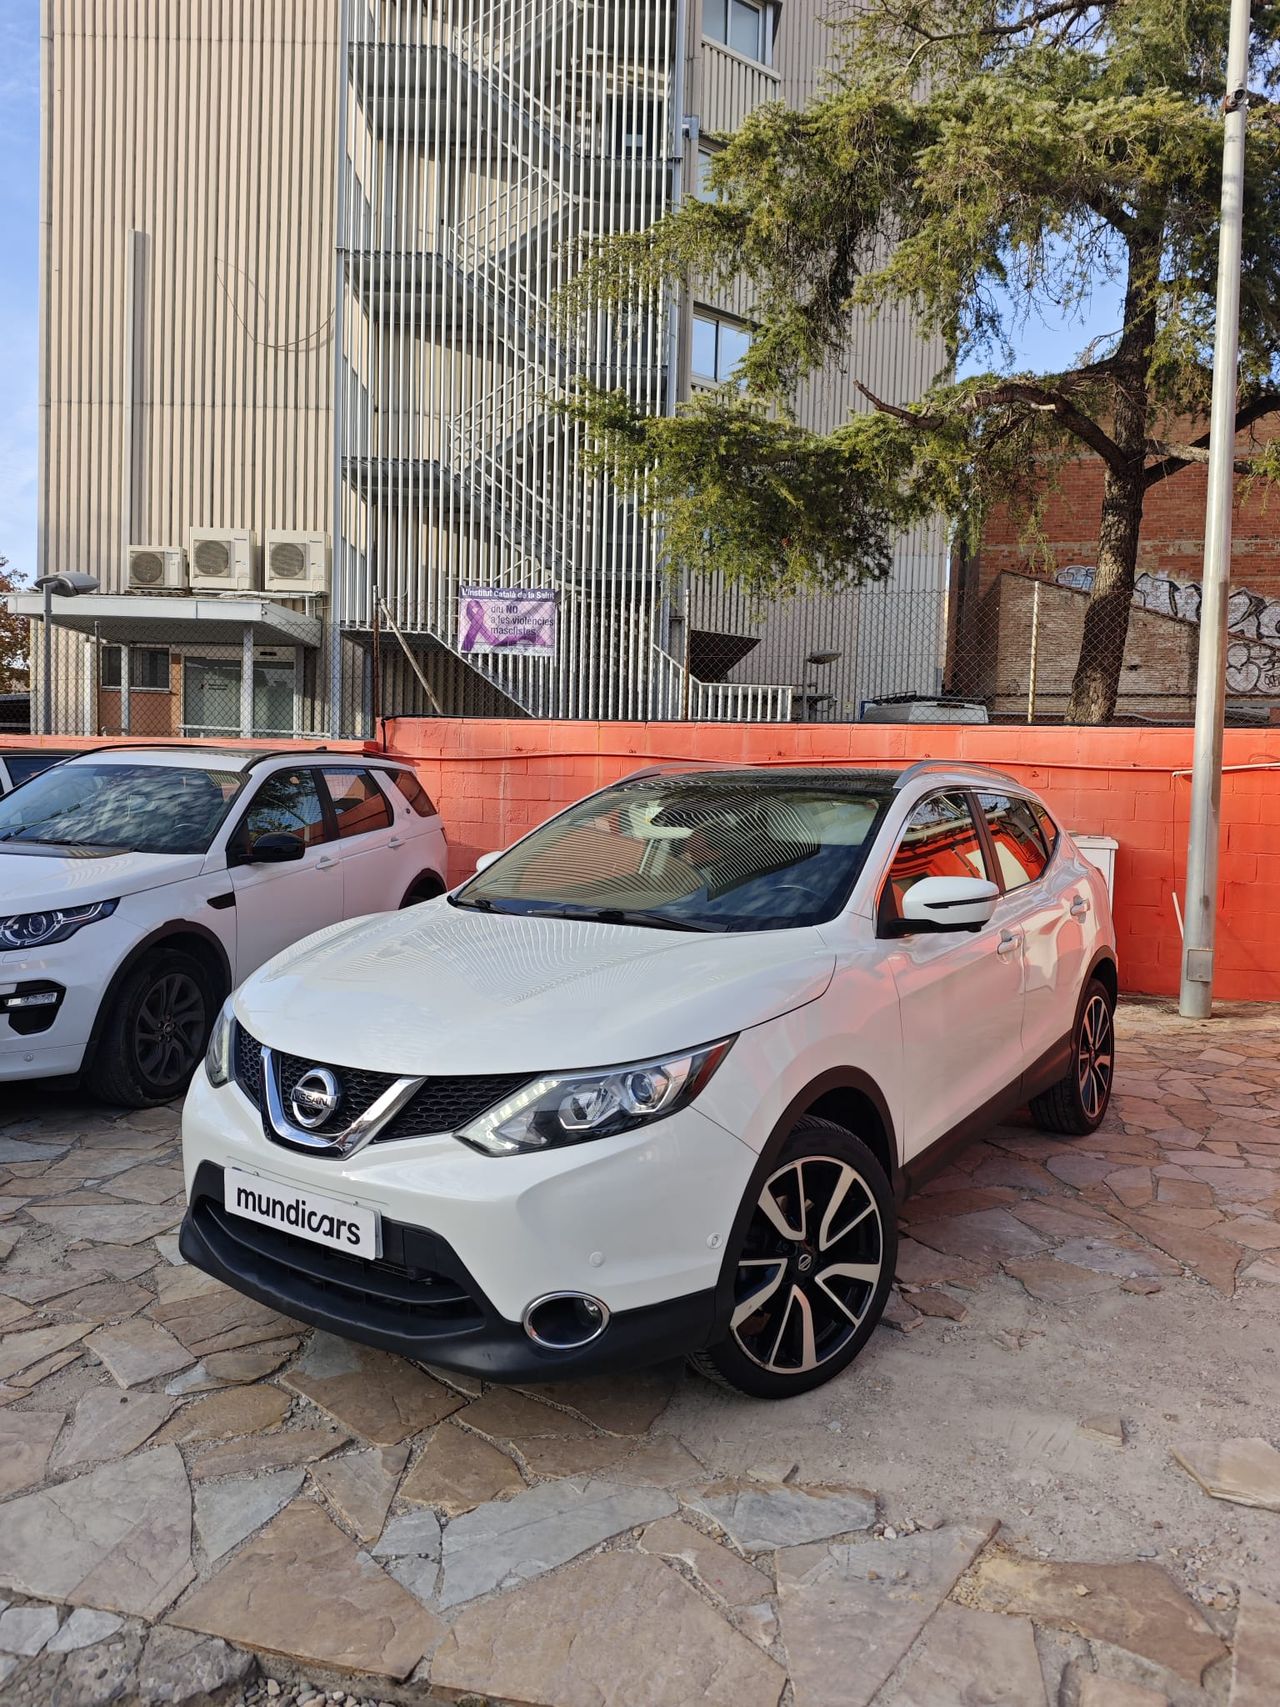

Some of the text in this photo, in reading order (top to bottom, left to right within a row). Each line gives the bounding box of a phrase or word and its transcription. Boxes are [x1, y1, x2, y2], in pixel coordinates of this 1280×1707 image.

[527, 591, 535, 600] la
[536, 591, 555, 600] Salut
[506, 605, 518, 614] NO
[237, 1187, 361, 1245] mundicars
